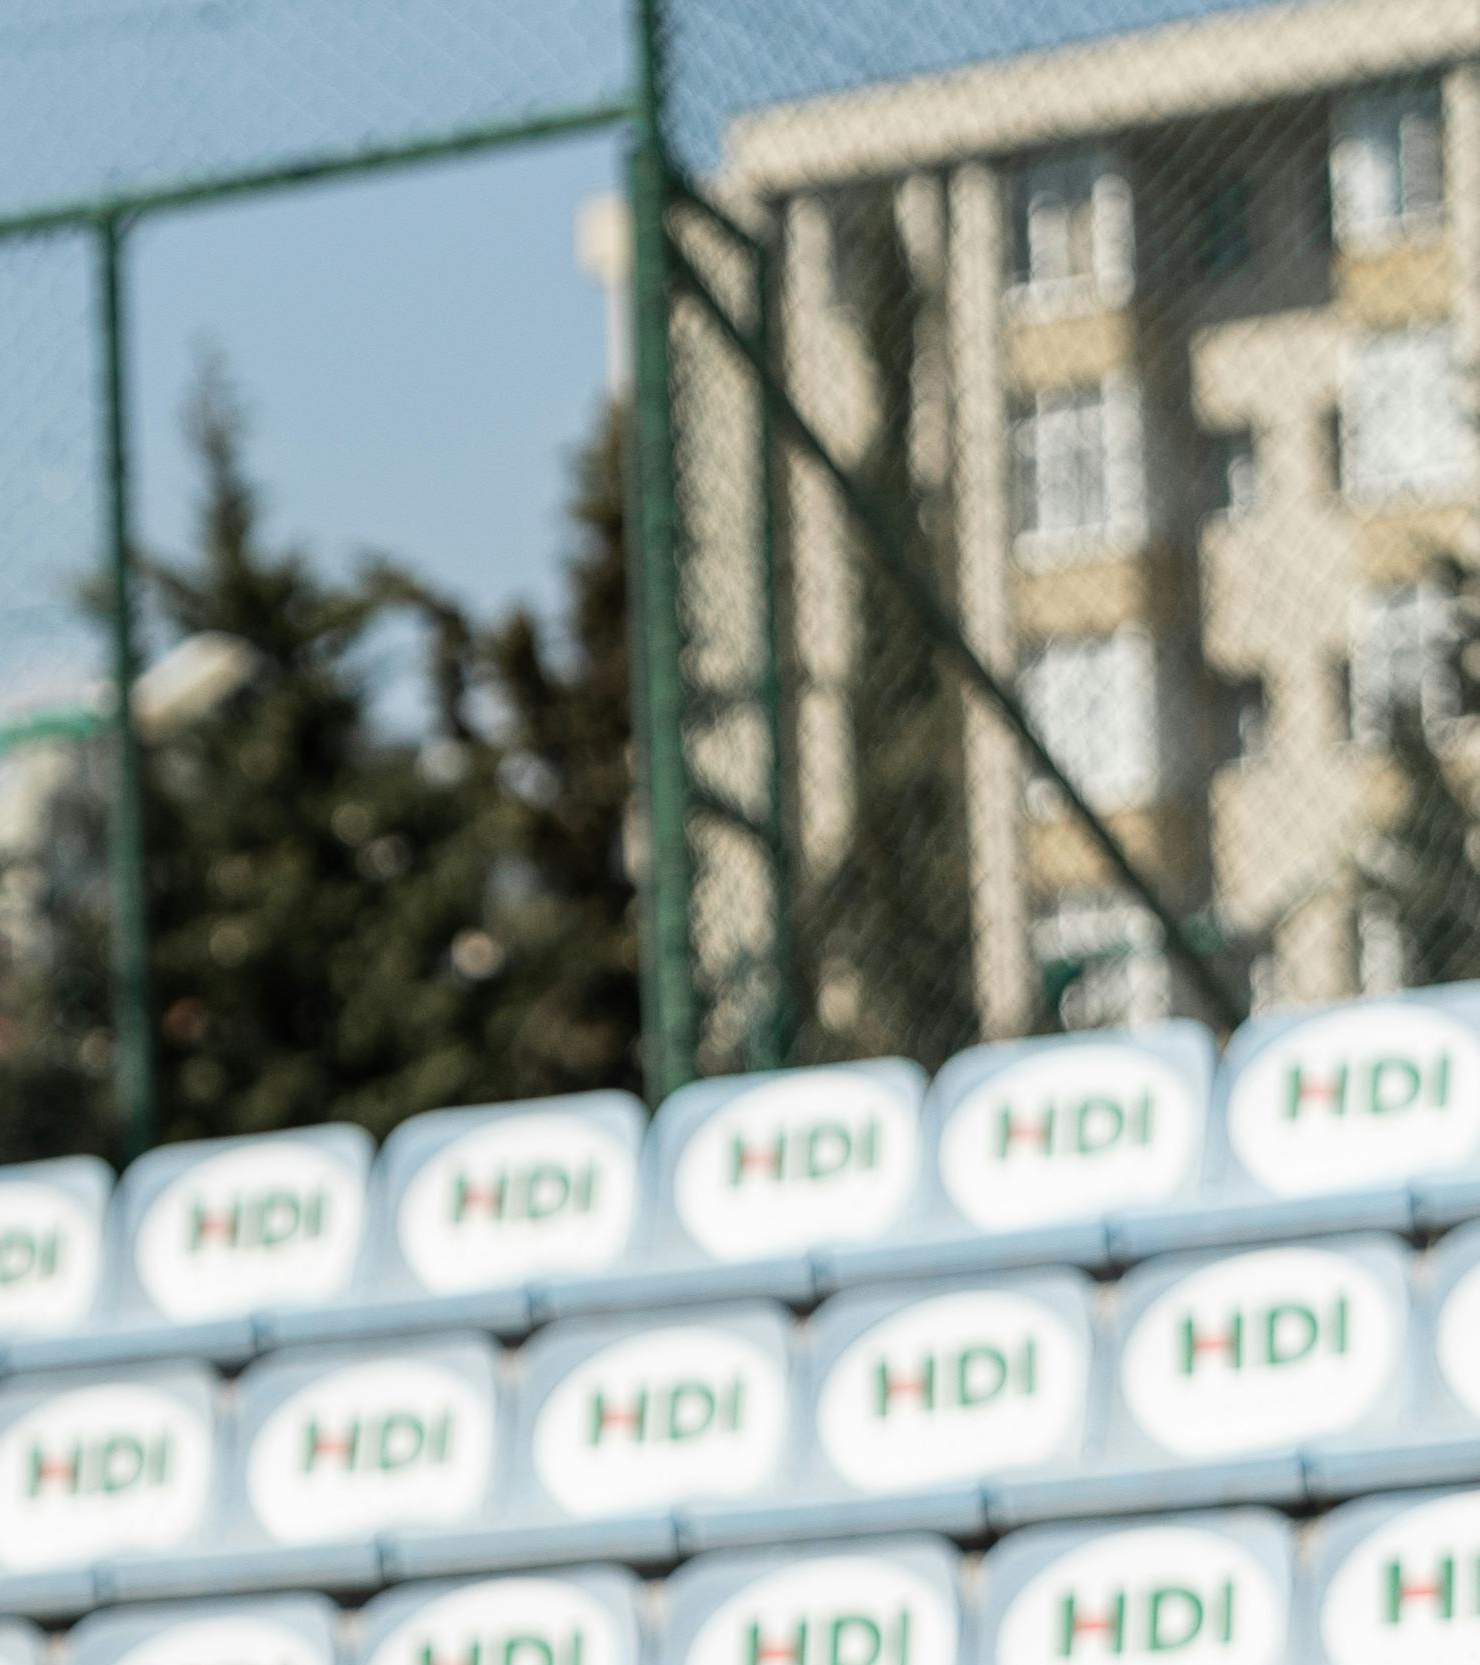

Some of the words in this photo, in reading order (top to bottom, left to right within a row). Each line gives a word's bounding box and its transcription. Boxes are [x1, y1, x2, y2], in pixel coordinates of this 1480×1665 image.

[1281, 1053, 1454, 1122] HDI
[725, 1120, 881, 1190] HDI
[993, 1092, 1154, 1161] HDI
[187, 1189, 323, 1254] HDI
[450, 1161, 600, 1229] HDI
[1177, 1293, 1350, 1379] HDI
[873, 1336, 1037, 1419] HDI
[303, 1412, 452, 1474] HDI
[589, 1378, 745, 1447] HDI
[28, 1428, 173, 1497] HDI
[1056, 1577, 1237, 1661] HDI
